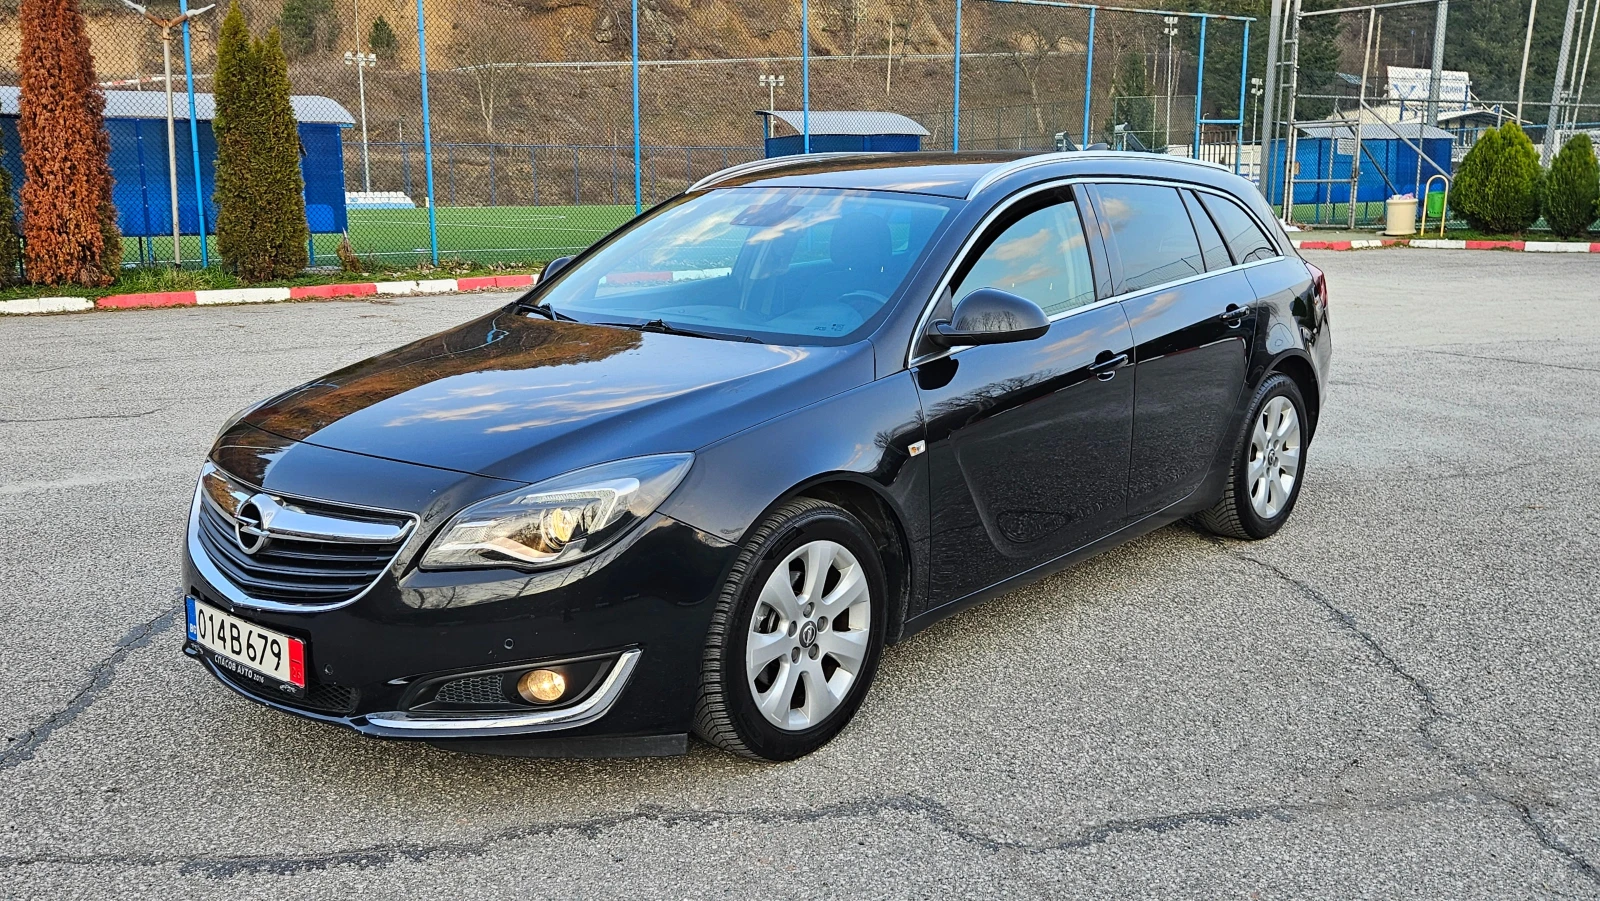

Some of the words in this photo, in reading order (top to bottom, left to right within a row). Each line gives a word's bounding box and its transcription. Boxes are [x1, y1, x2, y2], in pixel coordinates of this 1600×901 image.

[189, 623, 197, 634] BG
[198, 608, 281, 671] 014B679
[214, 654, 236, 671] СПАСОВ
[237, 664, 253, 679] АУТО
